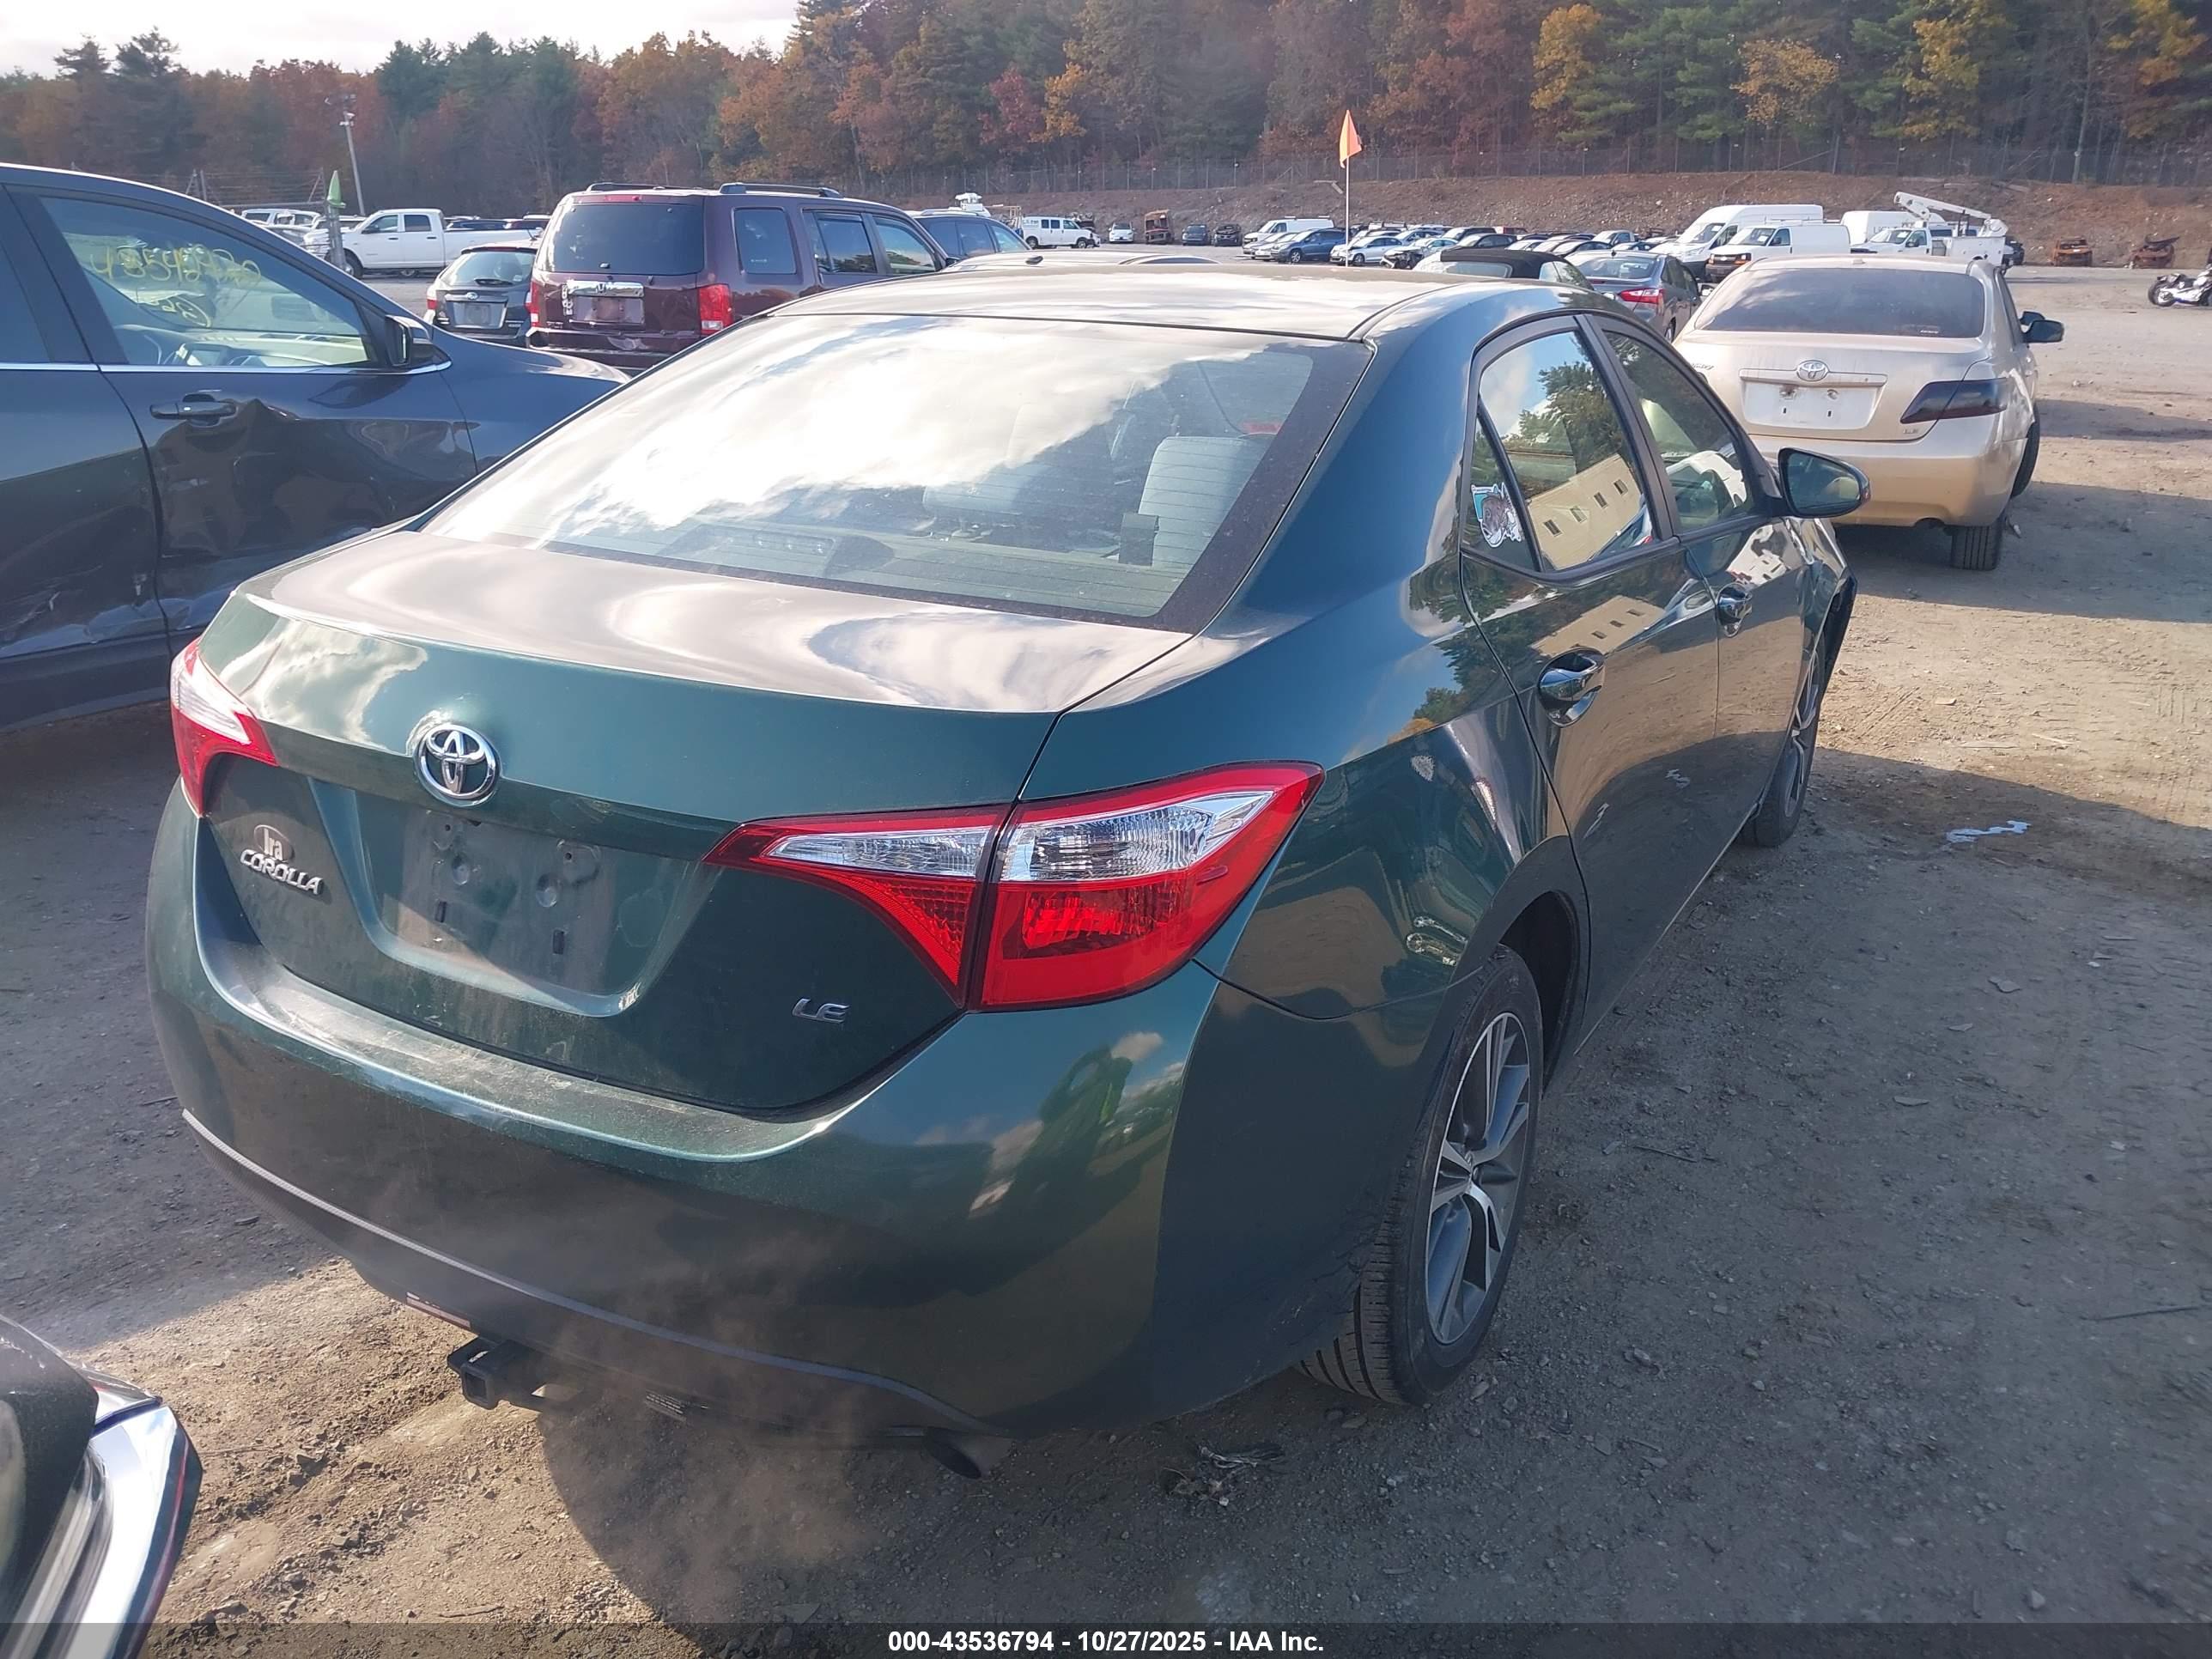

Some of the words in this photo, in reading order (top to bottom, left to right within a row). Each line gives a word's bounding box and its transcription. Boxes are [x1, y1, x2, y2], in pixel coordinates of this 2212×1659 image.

[263, 828, 283, 860] Ira
[240, 848, 324, 895] COROLLA
[792, 998, 850, 1024] LE
